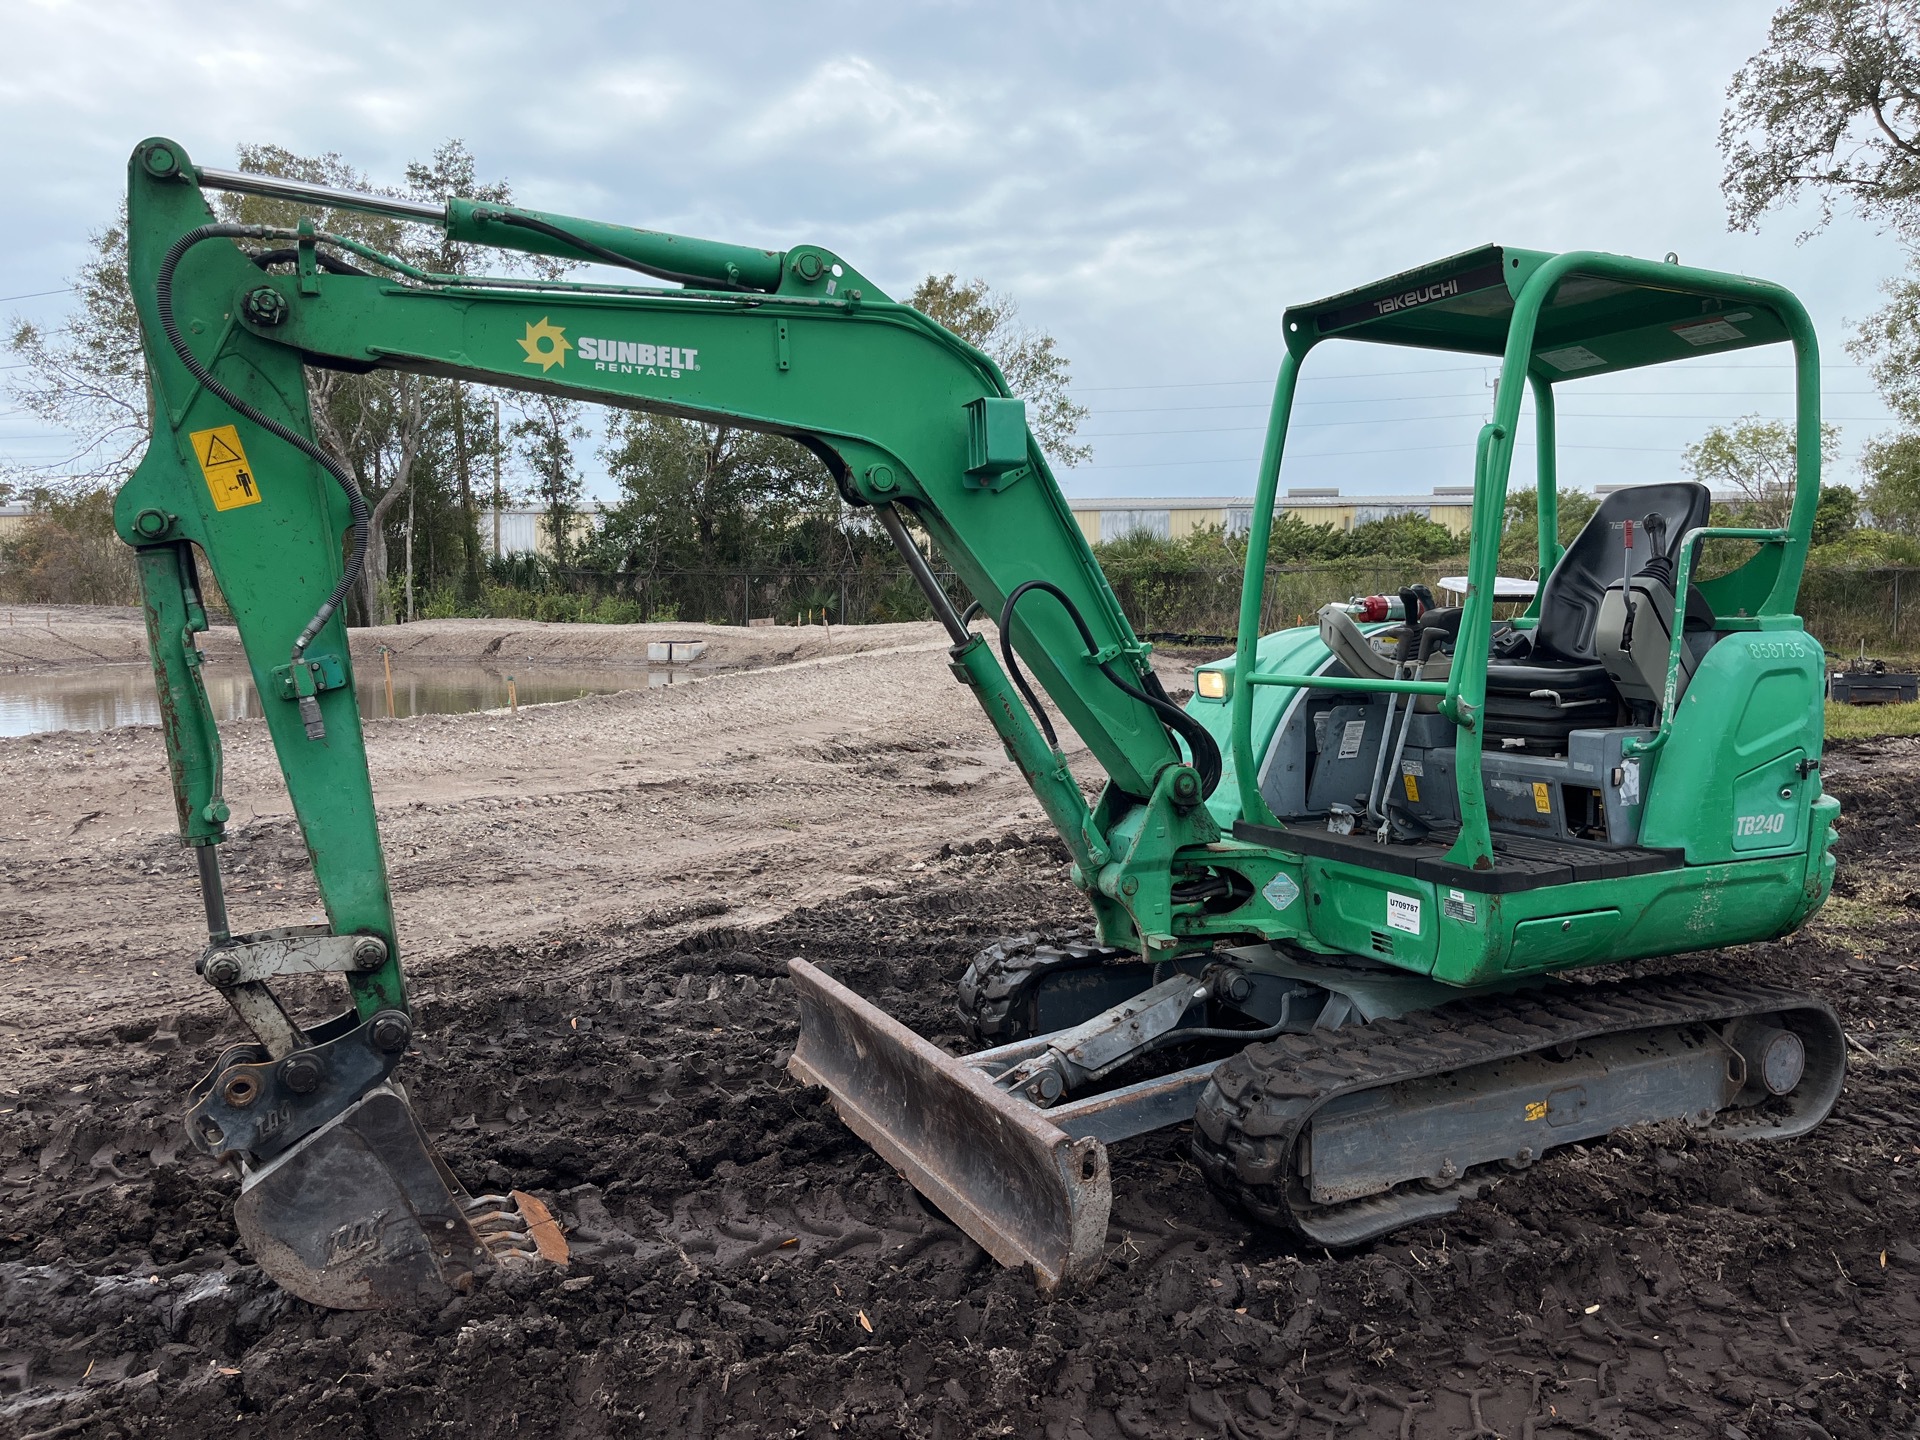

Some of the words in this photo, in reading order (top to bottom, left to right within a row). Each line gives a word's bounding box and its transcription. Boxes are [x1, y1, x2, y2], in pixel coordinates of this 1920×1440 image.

[578, 337, 698, 371] SUNBELT
[595, 362, 681, 379] RENTALS
[1749, 642, 1805, 659] 858735
[1737, 813, 1785, 836] TB240
[1390, 899, 1418, 913] U709787
